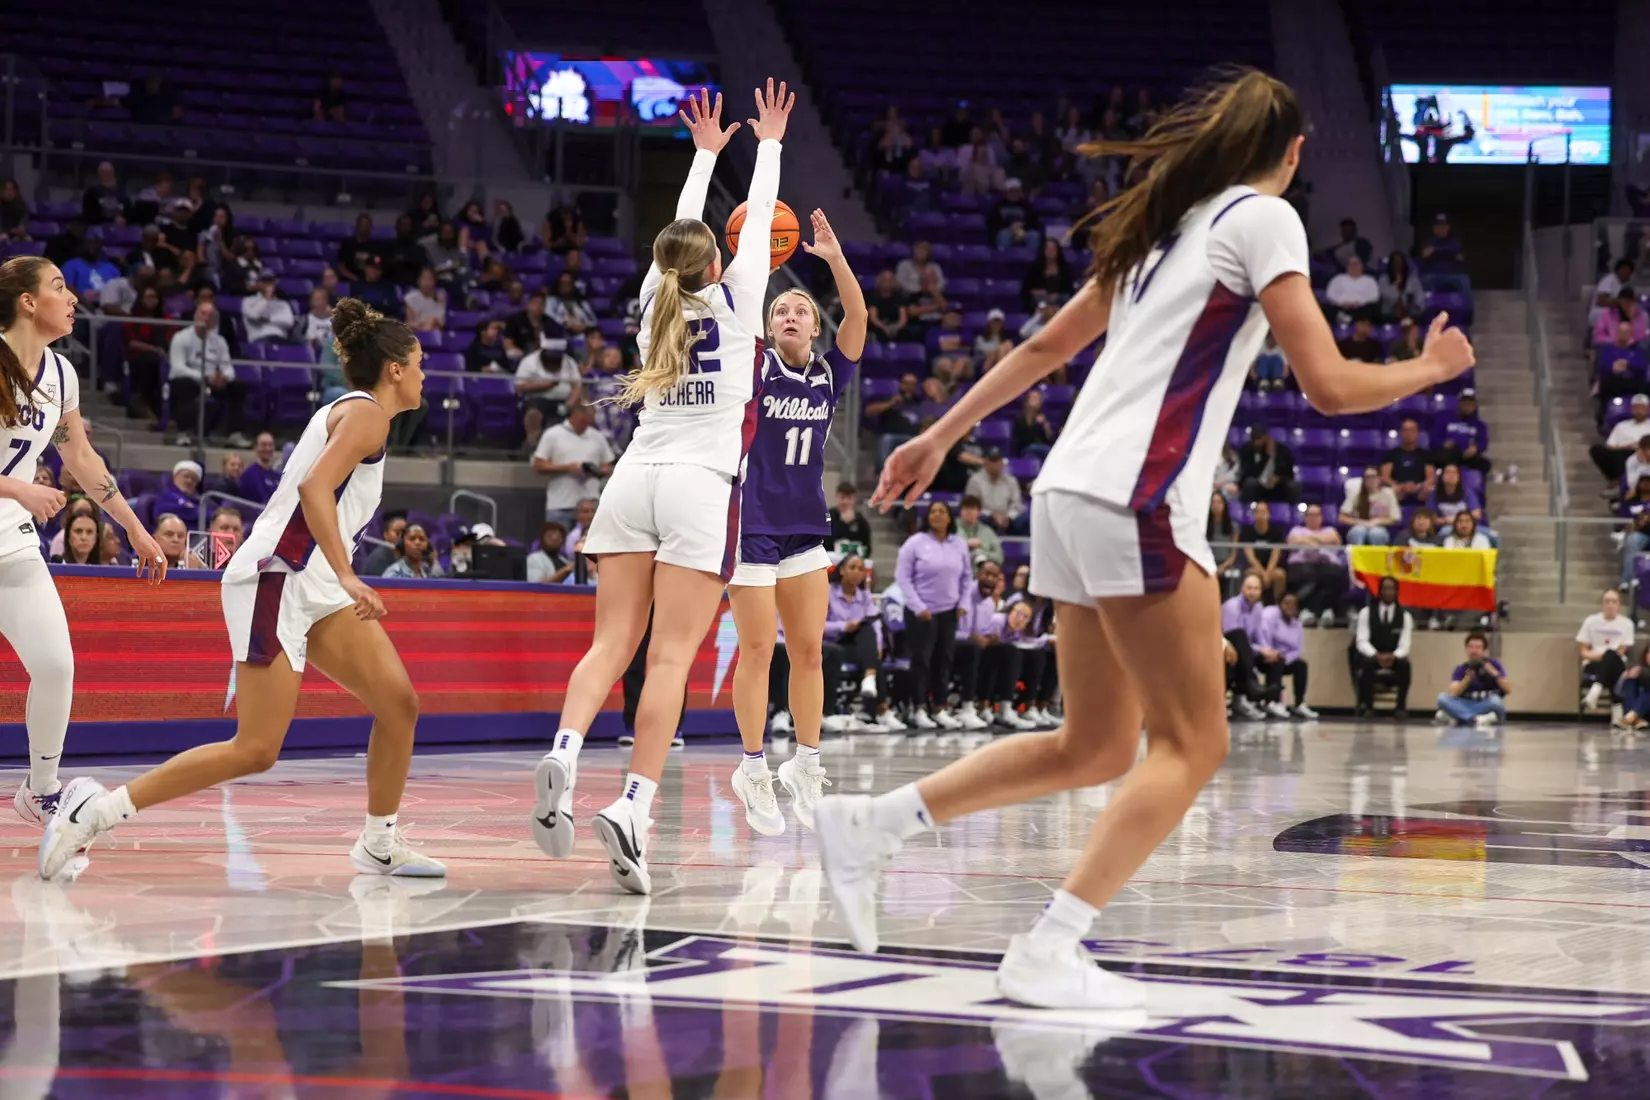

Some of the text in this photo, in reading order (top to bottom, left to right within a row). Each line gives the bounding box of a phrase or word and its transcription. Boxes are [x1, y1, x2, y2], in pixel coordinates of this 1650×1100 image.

[763, 395, 829, 420] Wildcats
[1, 438, 32, 476] 7
[784, 427, 813, 466] 11
